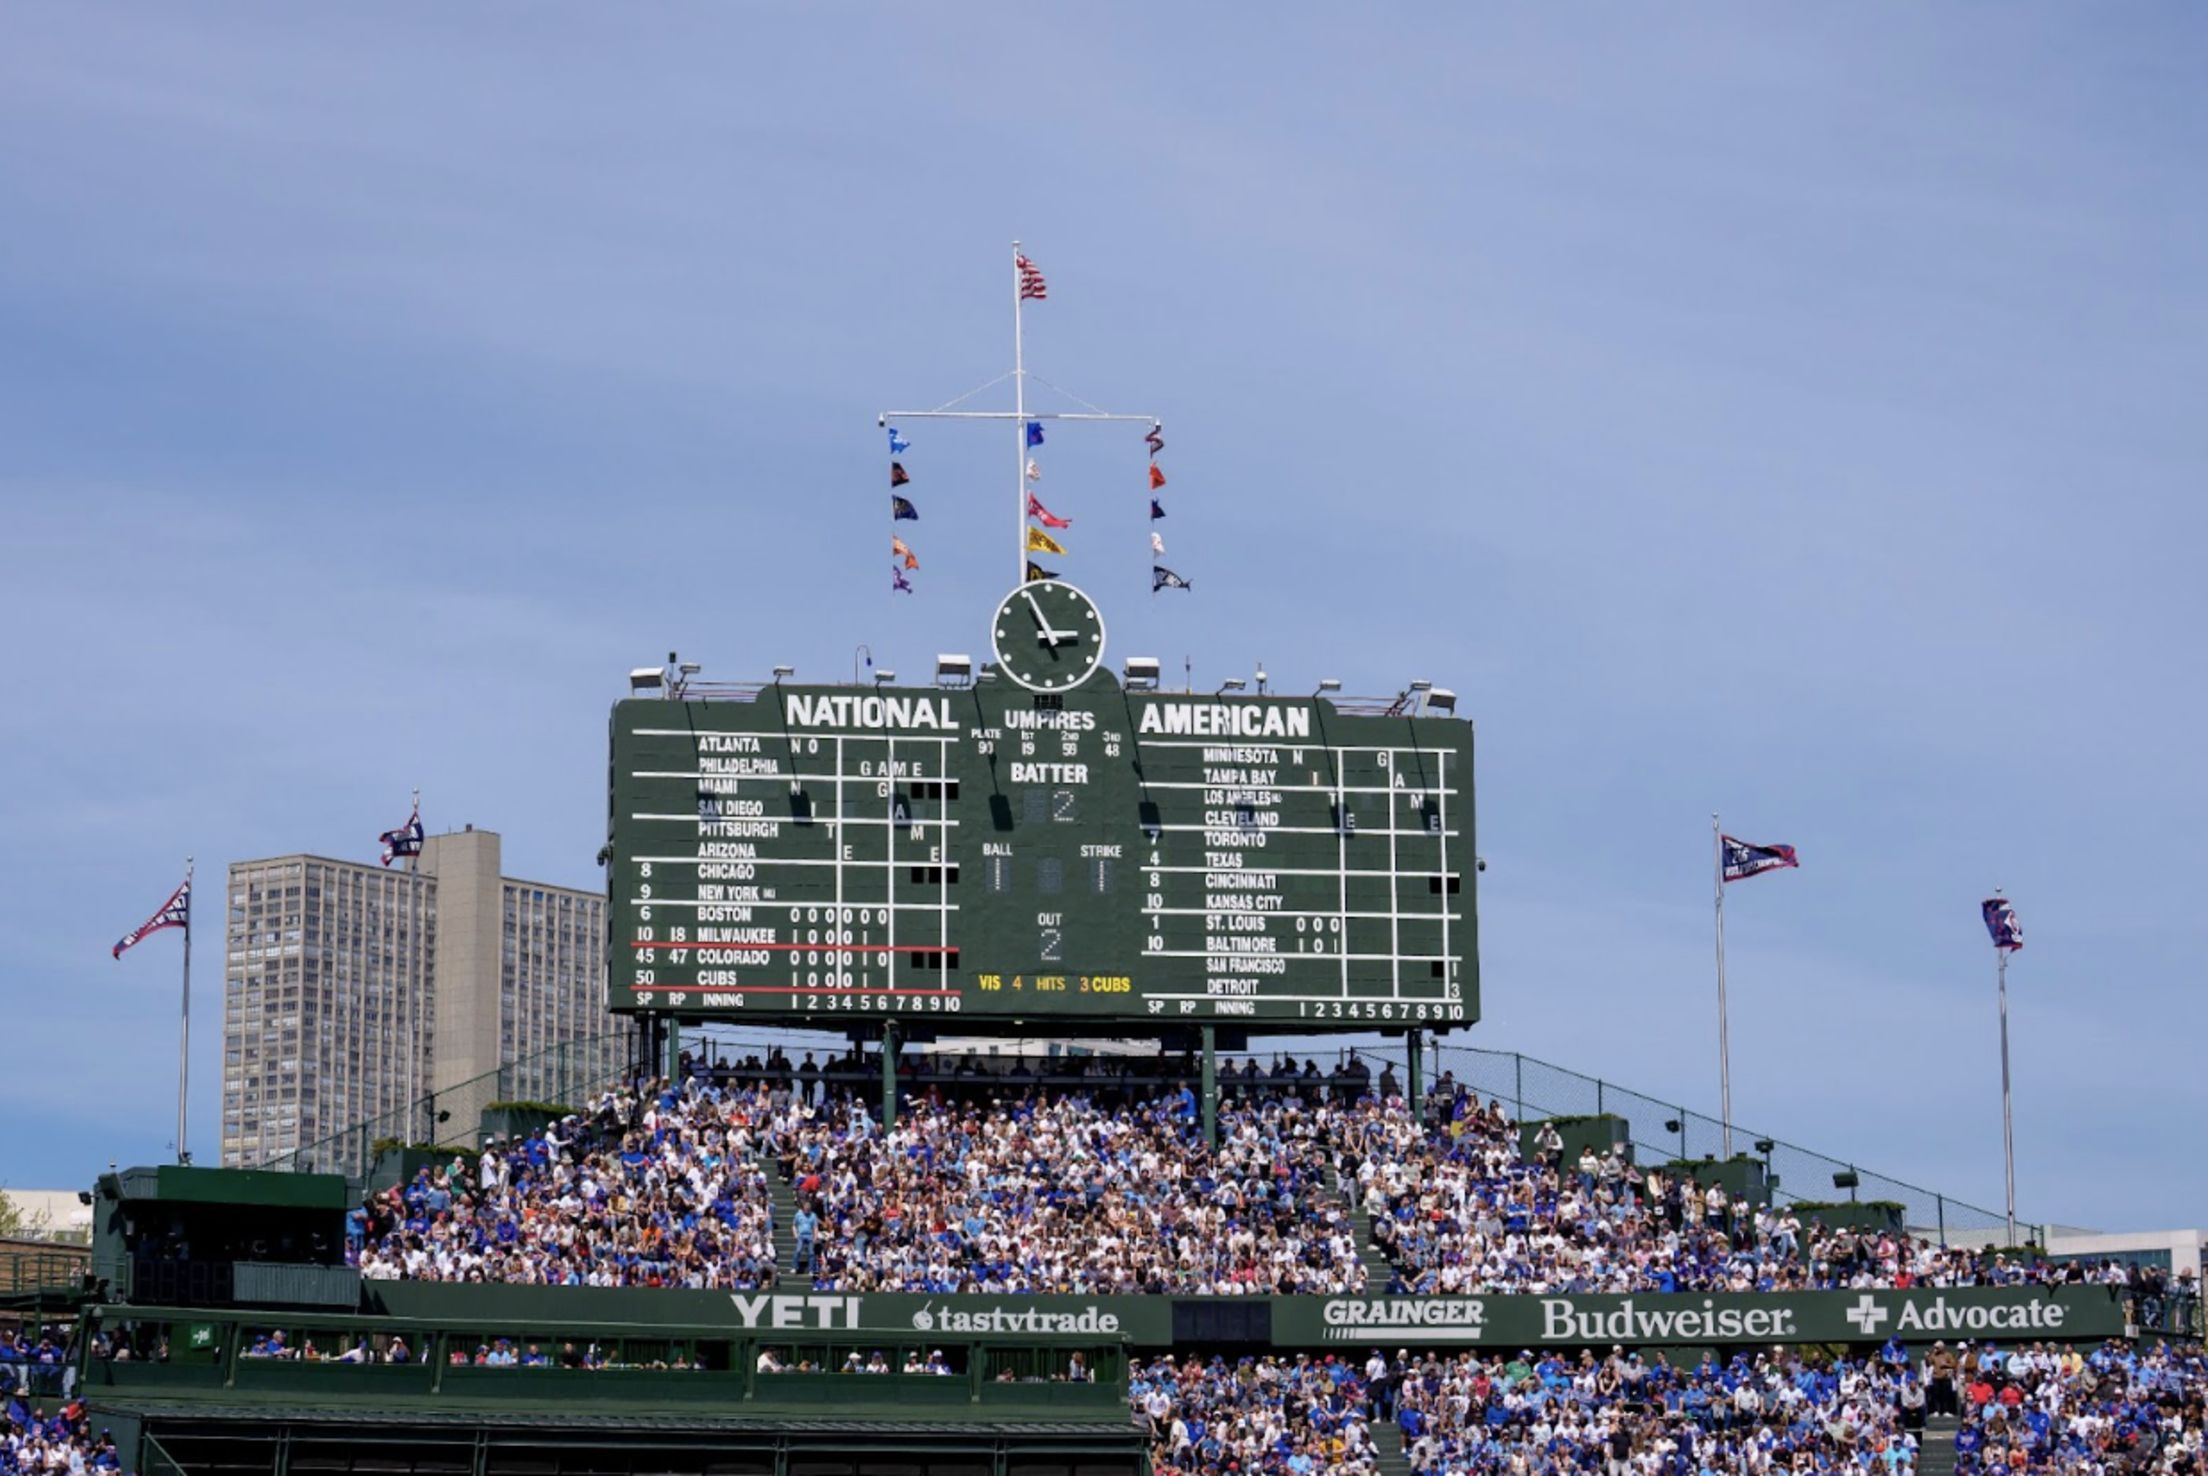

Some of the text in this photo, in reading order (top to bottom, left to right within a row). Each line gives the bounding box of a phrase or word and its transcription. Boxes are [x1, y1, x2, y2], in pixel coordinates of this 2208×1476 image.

[787, 695, 959, 729] NATIONAL
[1005, 710, 1095, 731] UMPIRES
[1140, 704, 1309, 736] AMERICAN
[699, 737, 760, 753] ATLANTA
[1022, 742, 1035, 755] 19
[1105, 744, 1119, 756] 48
[1204, 748, 1278, 763] MINNESOTA
[699, 758, 778, 775] PHILADELPHIA
[1011, 763, 1088, 783] BATTER
[1204, 769, 1247, 785] TAMPA
[1250, 770, 1276, 786] BAY
[699, 779, 738, 794] MIAMI
[1205, 790, 1224, 805] LOS
[1227, 791, 1271, 805] ANGELES
[698, 801, 724, 816] SAN
[727, 800, 763, 817] DIEGO
[1054, 791, 1074, 822] 2
[1205, 812, 1279, 827] CLEVELAND
[699, 822, 778, 837] PITTSBURGH
[1204, 831, 1266, 847] TORONTO
[698, 843, 756, 858] ARIZONA
[983, 843, 1012, 855] BALL
[1081, 845, 1121, 857] STRIKE
[1151, 852, 1242, 867] 4 TEXAS
[641, 862, 754, 880] 8 CHICAGO
[1150, 872, 1278, 889] 8 CINCINNATI
[641, 885, 651, 899] 9
[698, 886, 724, 900] NEW
[727, 887, 760, 901] YORK
[1148, 893, 1283, 910] 10 KANSAS CITY
[640, 906, 651, 920] 6
[698, 906, 751, 921] BOSTON
[1038, 913, 1061, 926] OUT
[1206, 916, 1225, 930] ST.
[1229, 916, 1265, 931] LOUIS
[637, 927, 653, 943] 10
[669, 928, 686, 942] 18
[698, 927, 775, 944] MILWAUKEE
[1148, 936, 1163, 951] 10
[1206, 937, 1276, 952] BALTIMORE
[1041, 929, 1061, 960] 2
[636, 947, 654, 963] 45
[669, 948, 688, 964] 47
[697, 947, 771, 965] COLORADO
[1207, 958, 1226, 972] SAN
[1230, 959, 1285, 973] FRANCISCO
[636, 970, 654, 986] 50
[697, 971, 736, 987] CUBS
[979, 975, 1130, 992] VIS 4 HITS 3 CUBS
[1207, 980, 1459, 998] DETROIT 3
[637, 992, 653, 1005] SP
[669, 992, 686, 1006] RP
[703, 992, 743, 1006] INNING
[807, 995, 818, 1009] 2
[827, 995, 837, 1010] 3
[842, 995, 853, 1010] 4
[860, 995, 870, 1010] 5
[877, 995, 888, 1010] 6
[896, 995, 906, 1010] 7
[912, 995, 922, 1011] 8
[929, 995, 940, 1011] 9
[944, 995, 961, 1011] 10
[1148, 1000, 1165, 1013] SP
[1180, 1001, 1196, 1014] RP
[1215, 1000, 1255, 1015] INNING
[1315, 1003, 1325, 1017] 2
[1332, 1002, 1342, 1017] 3
[1349, 1003, 1359, 1017] 4
[1366, 1003, 1376, 1018] 5
[1382, 1004, 1392, 1018] 6
[1400, 1004, 1409, 1018] 7
[1416, 1004, 1426, 1018] 8
[1433, 1005, 1443, 1018] 9
[1449, 1005, 1464, 1019] 10
[730, 1295, 859, 1329] YETI
[1324, 1300, 1482, 1324] GRAINGER
[1540, 1300, 1791, 1338] Budweiser
[1897, 1297, 2063, 1329] Advocate
